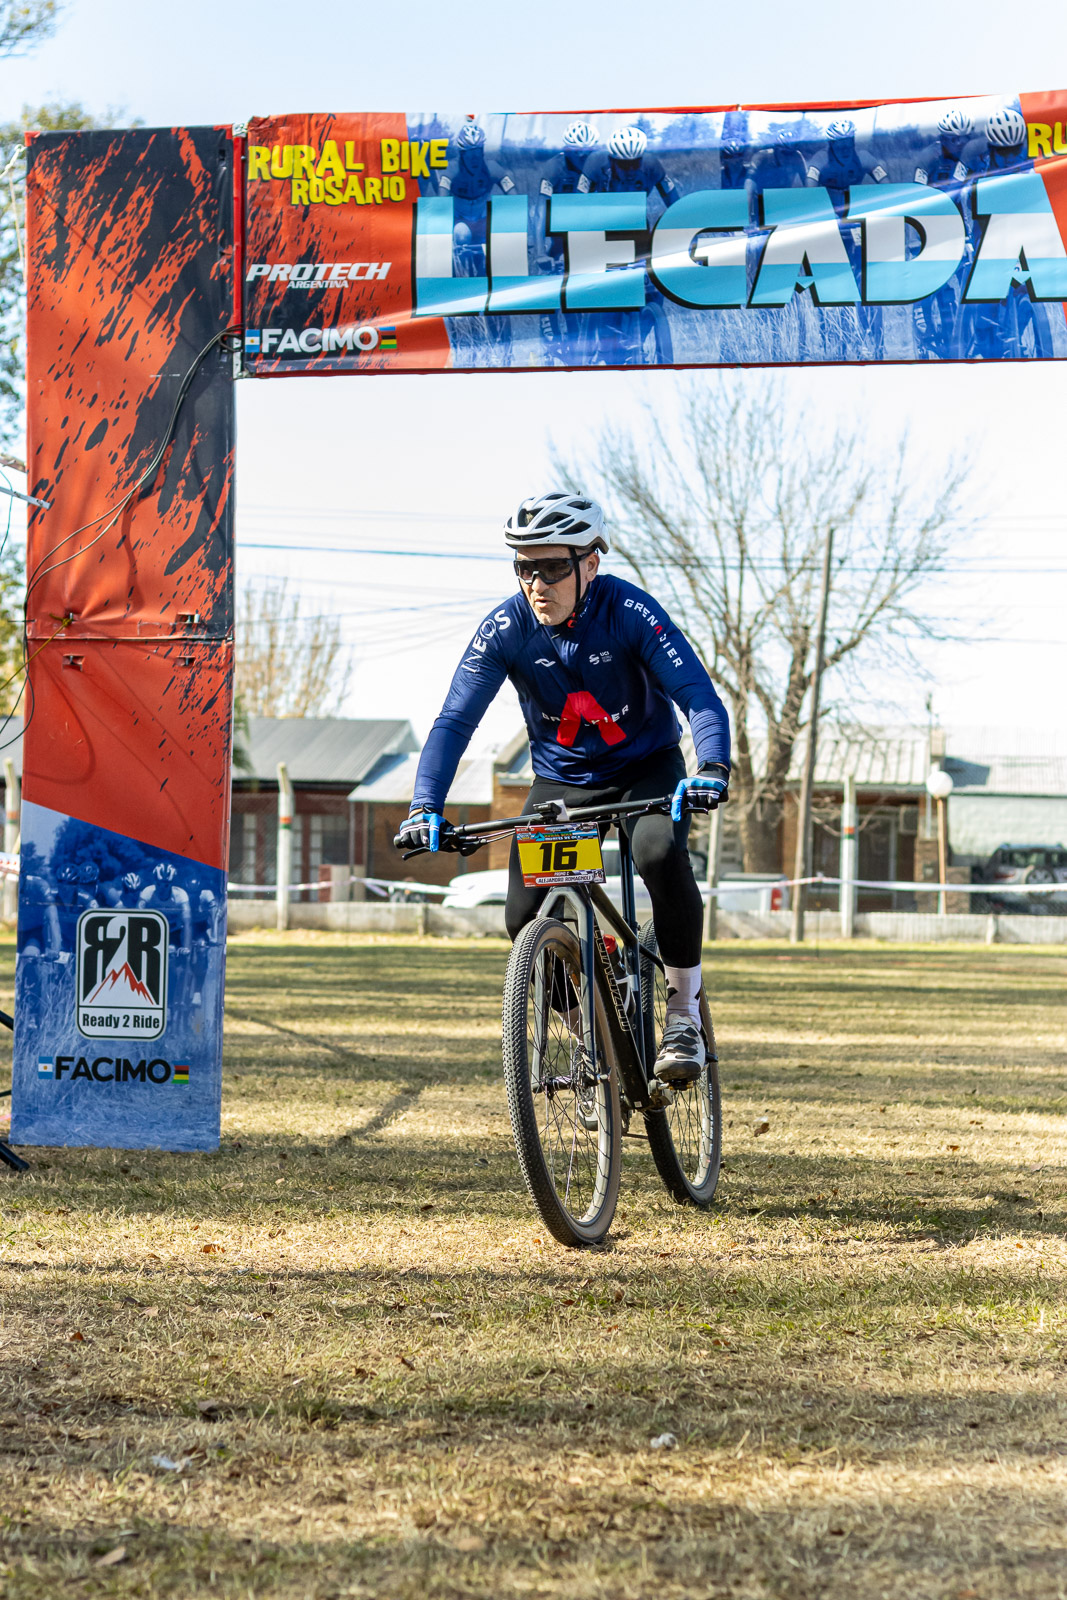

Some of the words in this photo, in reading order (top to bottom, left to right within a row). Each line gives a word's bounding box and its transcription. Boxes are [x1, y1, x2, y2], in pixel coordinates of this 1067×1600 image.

[247, 139, 365, 181] RURAL
[381, 138, 450, 179] BIKE
[290, 174, 407, 206] ROSARIO
[410, 173, 1067, 317] LLEGADA
[245, 262, 392, 282] PROTECH
[286, 280, 349, 289] ARGENTINA
[261, 326, 379, 353] FACIMO
[460, 609, 512, 674] INEOS
[539, 840, 579, 872] 16
[82, 1013, 120, 1029] Ready
[122, 1014, 130, 1028] 2
[133, 1014, 160, 1029] Ride
[55, 1056, 171, 1083] FACIMO
